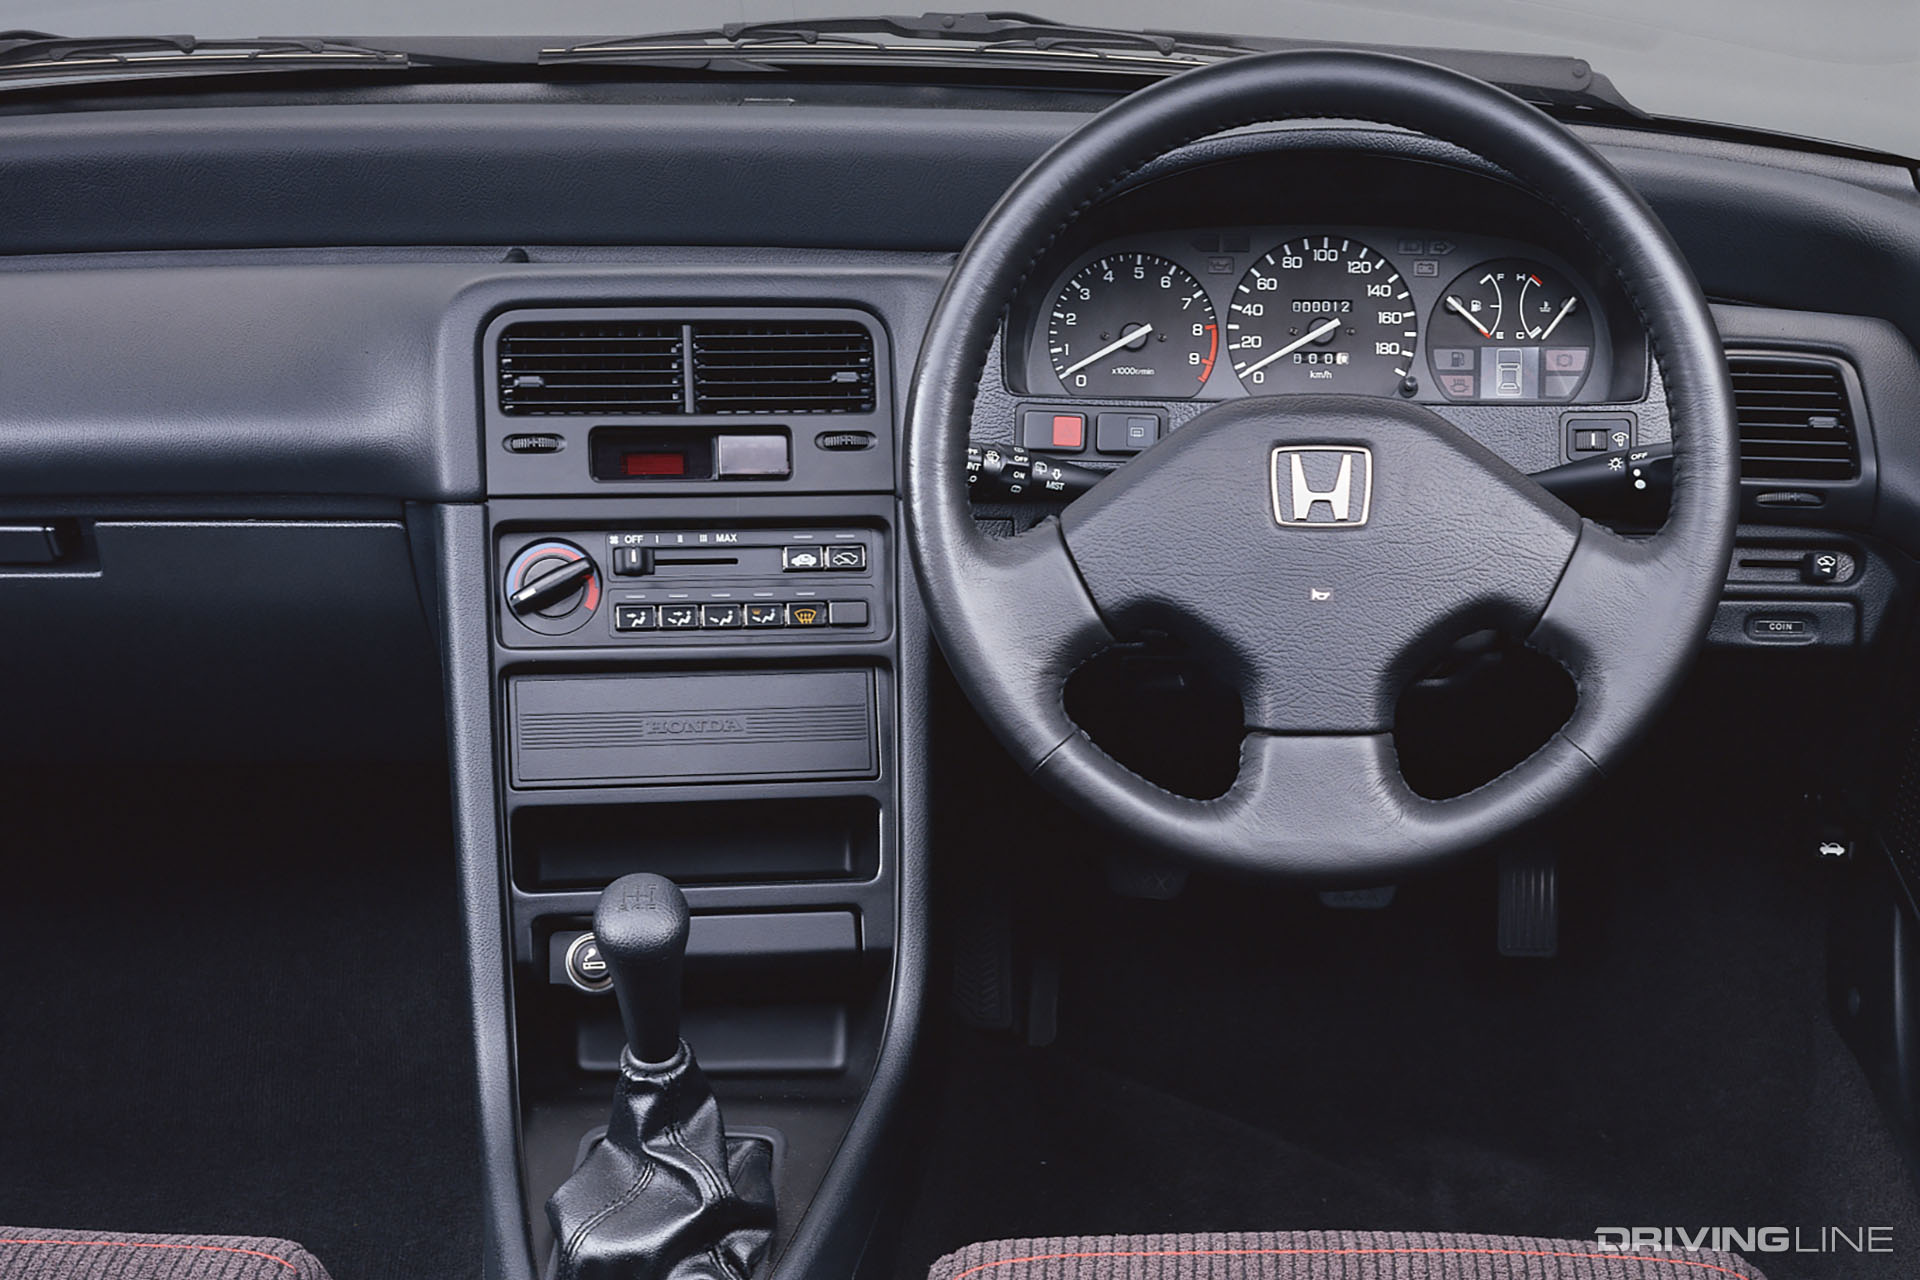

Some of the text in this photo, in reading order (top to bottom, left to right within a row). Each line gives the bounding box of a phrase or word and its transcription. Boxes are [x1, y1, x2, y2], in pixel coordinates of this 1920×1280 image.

[1313, 249, 1338, 261] 100
[1282, 256, 1302, 268] 80
[1347, 261, 1371, 273] 120
[1103, 270, 1114, 282] 4
[1134, 267, 1144, 279] 5
[1160, 276, 1171, 288] 6
[1256, 278, 1278, 290] 60
[1080, 288, 1090, 300] 3
[1367, 284, 1391, 297] 140
[1181, 297, 1192, 310] 7
[1241, 303, 1264, 316] 40
[1065, 313, 1077, 326] 2
[1377, 311, 1402, 324] 160
[1192, 323, 1203, 336] 8
[1241, 335, 1262, 348] 20
[1375, 342, 1400, 355] 180
[1188, 352, 1200, 365] 9
[1075, 374, 1087, 387] 0
[1252, 371, 1264, 383] 0
[1309, 370, 1332, 379] km/h
[1014, 455, 1028, 463] OFF
[1630, 451, 1648, 460] OFF
[1013, 471, 1025, 479] ON
[1045, 480, 1064, 490] MIST
[624, 535, 644, 544] OFF
[715, 533, 738, 543] MAX
[1769, 623, 1792, 631] COIN
[646, 719, 744, 734] HONDA
